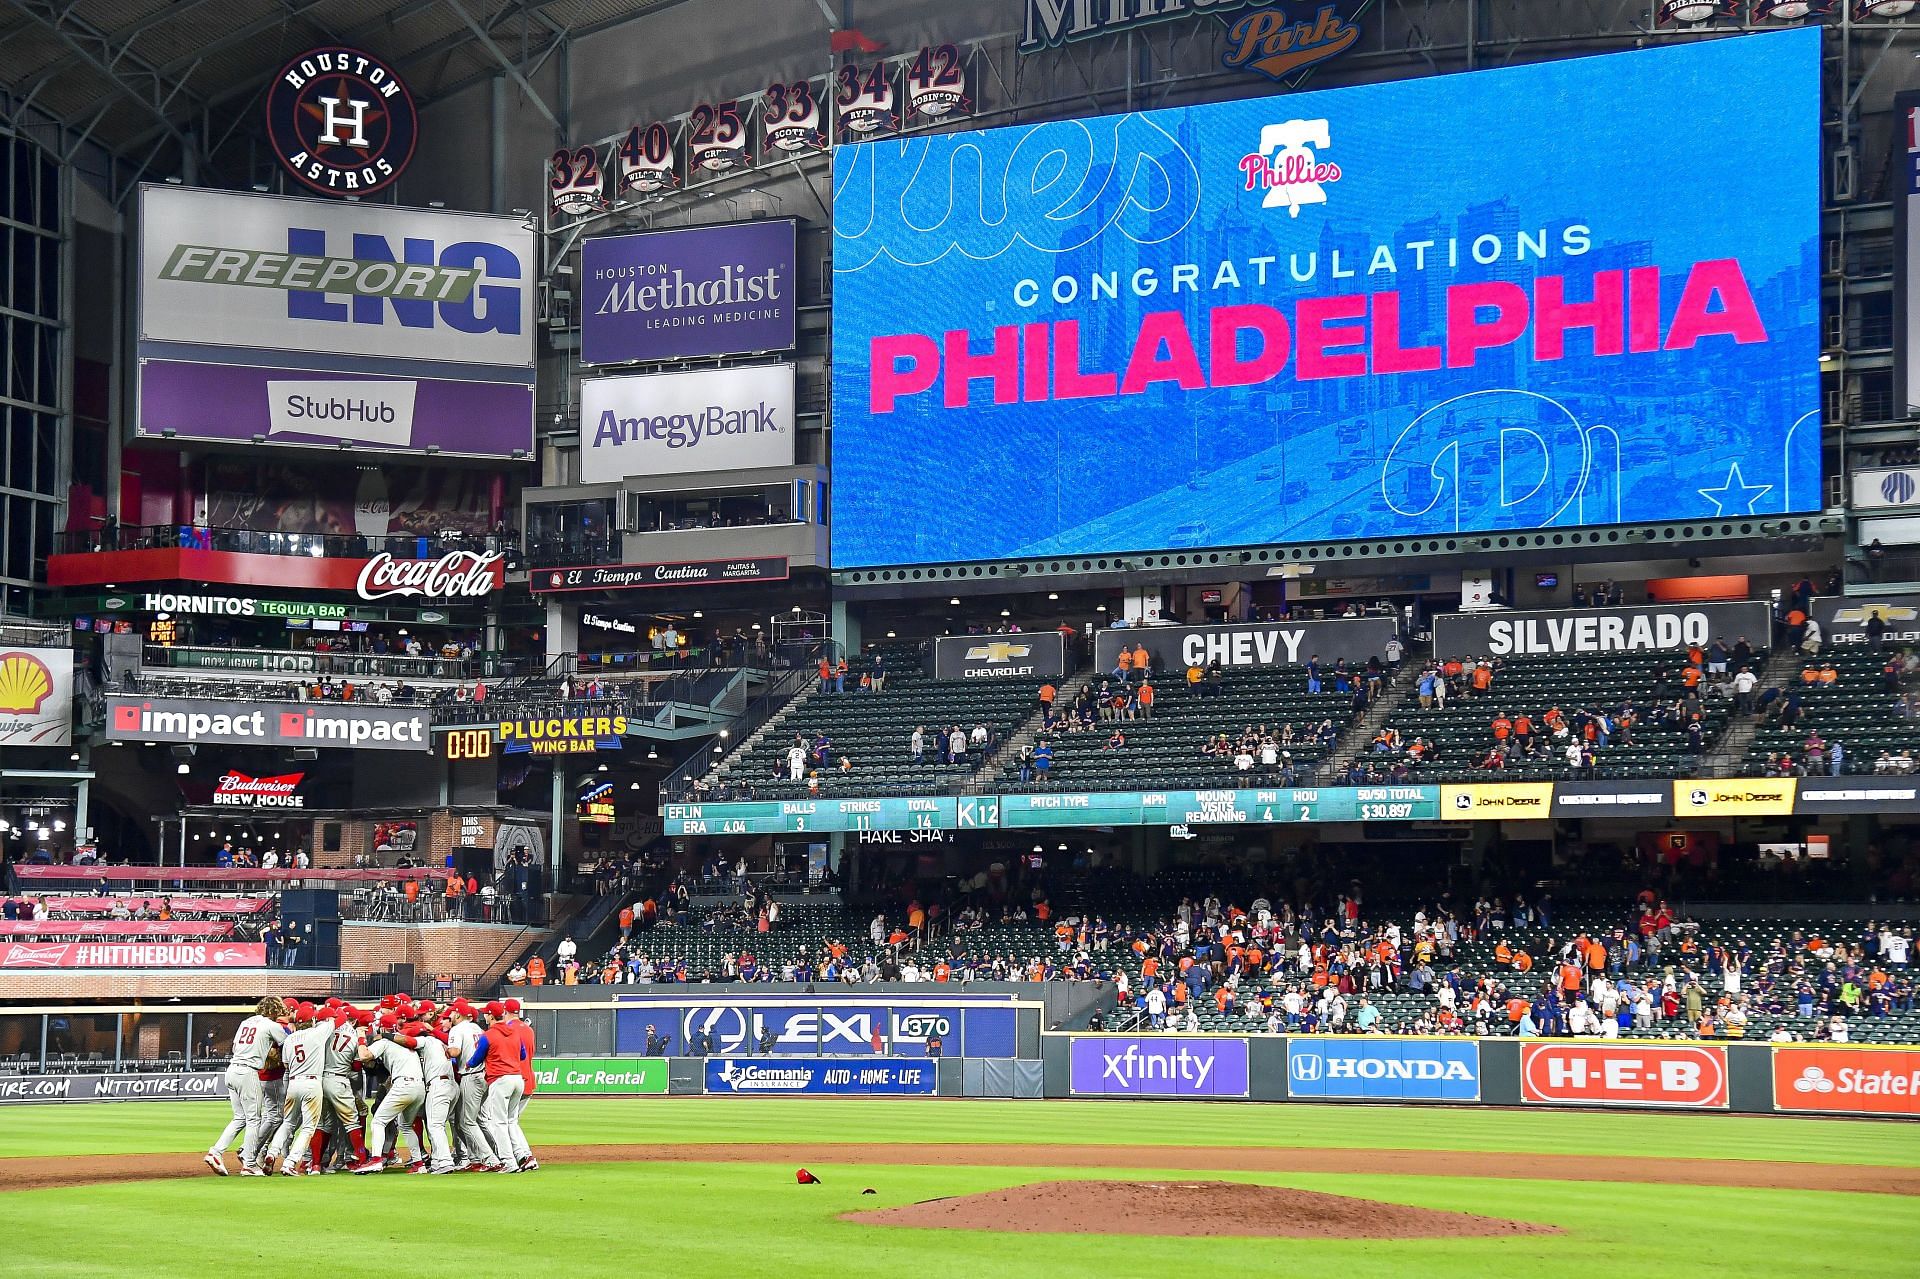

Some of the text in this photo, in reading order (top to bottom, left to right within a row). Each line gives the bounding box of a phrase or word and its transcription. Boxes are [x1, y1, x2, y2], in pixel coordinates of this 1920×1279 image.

[1226, 7, 1354, 66] Park
[285, 53, 400, 98] HOUSTON
[909, 44, 960, 89] 42
[837, 61, 888, 106] 34
[764, 80, 813, 124] 33
[318, 96, 369, 148] H
[689, 101, 739, 146] 25
[619, 122, 670, 167] 40
[290, 151, 393, 189] ASTROS
[551, 145, 597, 190] 32
[1240, 153, 1341, 191] Phillies
[170, 249, 472, 299] FREEPORT
[596, 263, 668, 280] HOUSTON
[1013, 225, 1590, 307] CONGRATULATIONS
[287, 227, 521, 335] LNG
[594, 264, 781, 315] Methodist
[646, 308, 780, 329] LEADING MEDICINE
[870, 257, 1769, 414] PHILADELPHIA
[286, 395, 395, 424] StubHub
[592, 401, 777, 449] AmegyBank
[357, 550, 505, 600] Coca-Cola
[568, 565, 708, 585] El Tiempo Cantina
[722, 569, 760, 577] MARGARITAS
[146, 594, 345, 617] HORNITOS TEQUILA BAR
[1488, 612, 1710, 655] SILVERADO
[1182, 629, 1305, 666] CHEVY
[964, 666, 1034, 678] CHEVROLET
[142, 703, 265, 739] impact
[306, 709, 422, 744] impact
[500, 716, 628, 740] PLUCKERS
[447, 730, 491, 759] 0:00
[532, 739, 595, 753] WING BAR
[218, 775, 296, 792] Budweiser
[213, 792, 304, 807] BREW HOUSE
[1031, 795, 1089, 808] PITCH TYPE
[1142, 794, 1166, 805] MPH
[1196, 791, 1236, 802] MOUND
[1257, 792, 1276, 802] PHI
[1293, 791, 1318, 802] HOU
[1357, 789, 1424, 800] 50/50 TOTAL
[1506, 795, 1541, 806] DEERE
[1745, 792, 1783, 802] DEERE
[668, 806, 702, 819] EFLIN
[783, 803, 816, 814] BALLS
[839, 800, 881, 813] STRIKES
[907, 800, 938, 811] TOTAL
[958, 803, 998, 826] K 12
[1200, 802, 1234, 812] VISITS
[1263, 807, 1273, 821] 4
[1301, 806, 1309, 821] 2
[461, 816, 479, 826] THIS
[796, 817, 804, 832] 3
[857, 816, 869, 829] 11
[917, 814, 931, 828] 14
[1185, 811, 1246, 823] REMAINING
[461, 826, 484, 836] BUD'S
[683, 820, 746, 834] ERA 4.04
[461, 836, 476, 846] FOR
[11, 945, 206, 965] Budweiser #HITTHEBUDS
[239, 1026, 256, 1044] 28
[909, 1018, 949, 1036] 370
[332, 1032, 351, 1053] 17
[295, 1044, 305, 1063] 5
[745, 1066, 811, 1081] Germania
[1103, 1044, 1215, 1088] xfinity
[1327, 1059, 1474, 1080] HONDA
[1548, 1057, 1700, 1092] H-E-B
[95, 1076, 219, 1096] NITTOTIRE.COM
[566, 1071, 593, 1085] Car
[595, 1071, 645, 1085] Rental
[824, 1069, 921, 1085] AUTO HOME LIFE
